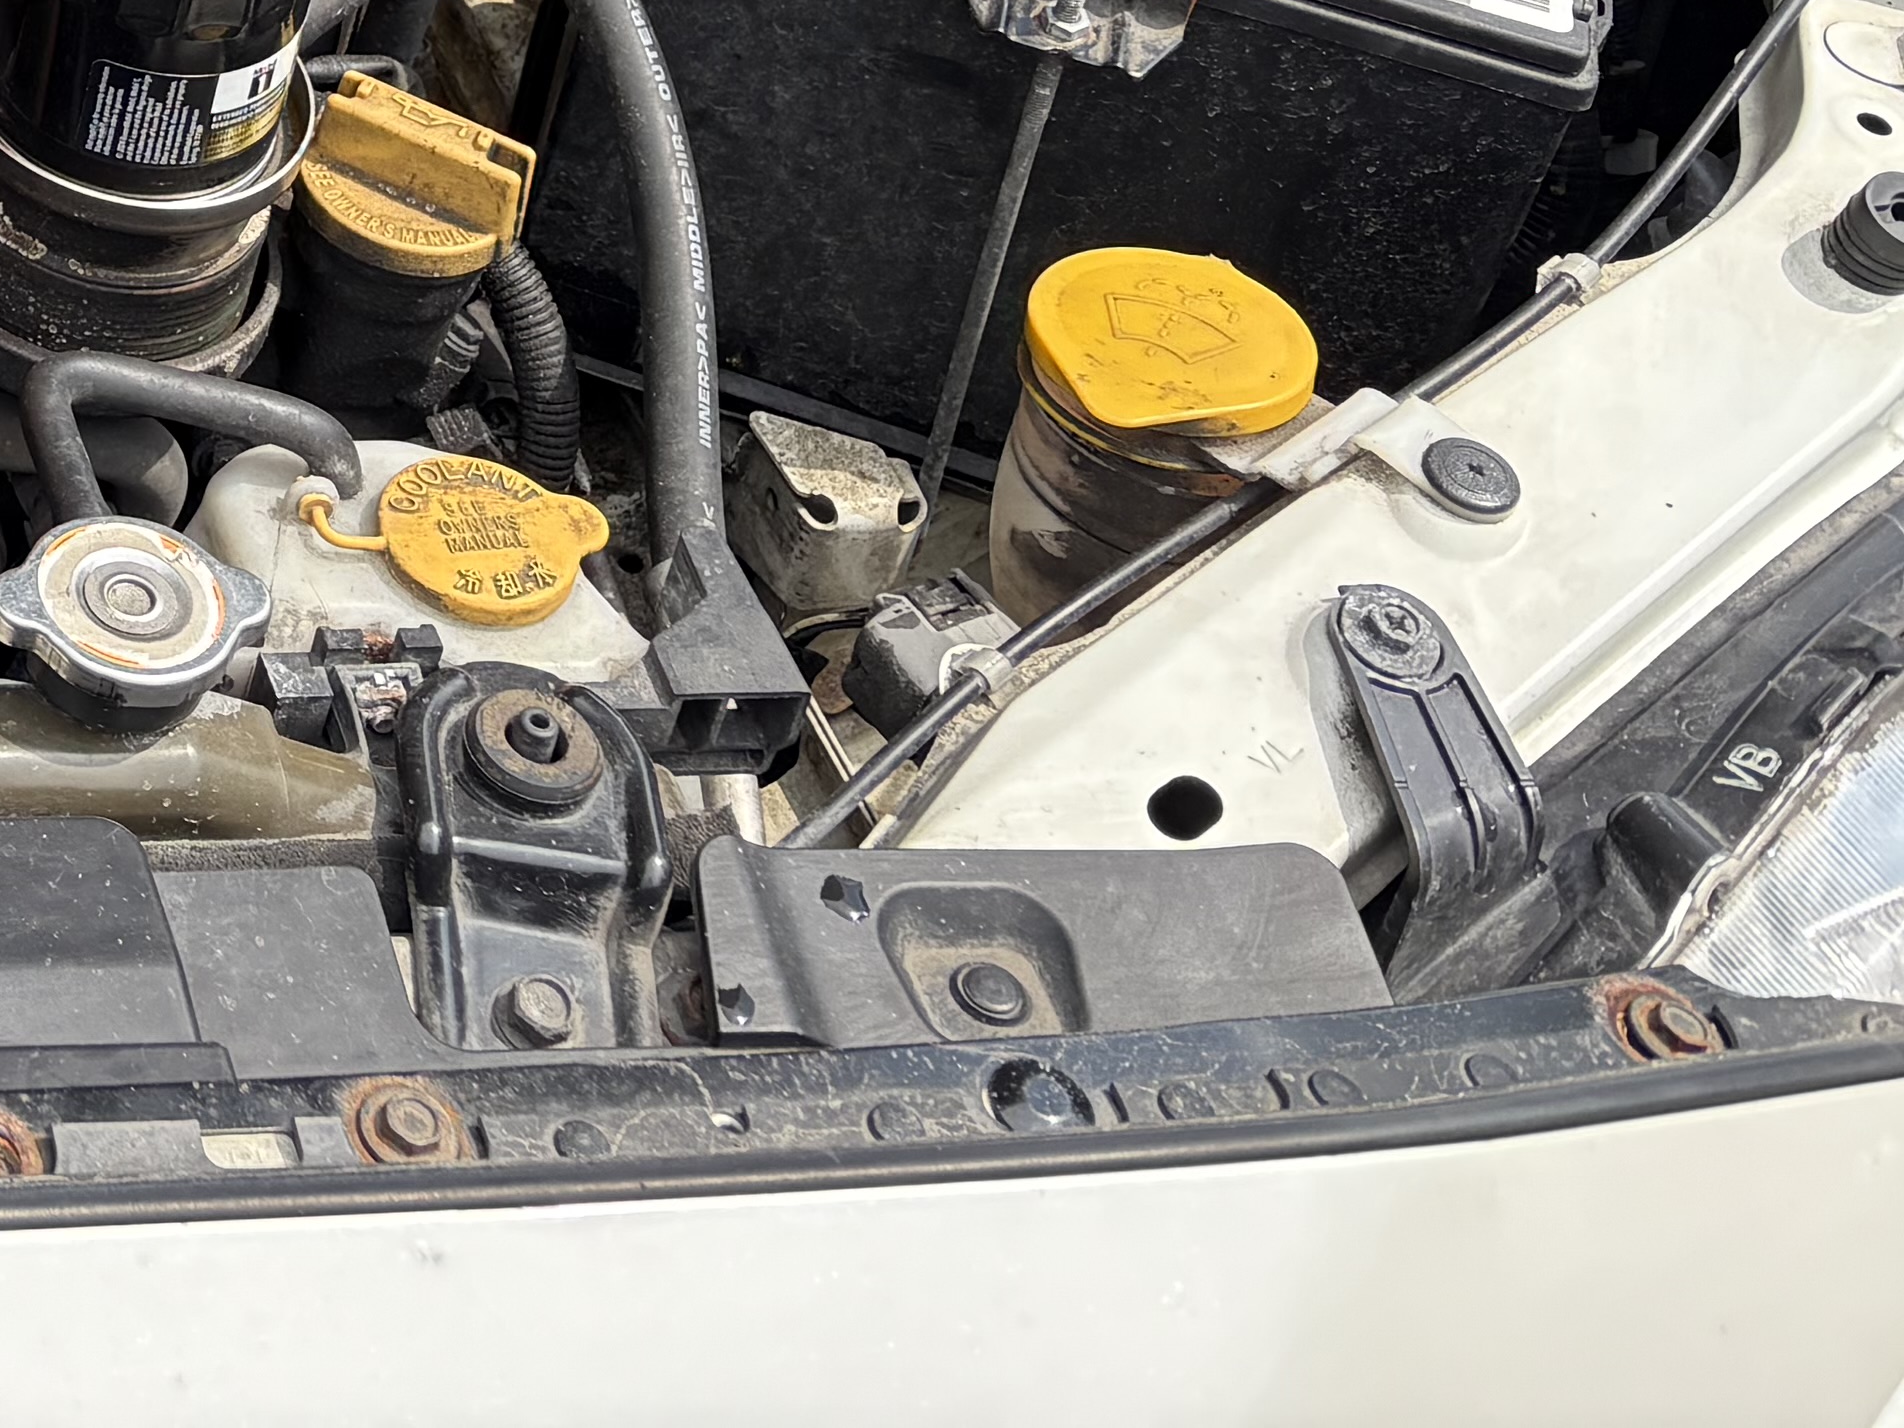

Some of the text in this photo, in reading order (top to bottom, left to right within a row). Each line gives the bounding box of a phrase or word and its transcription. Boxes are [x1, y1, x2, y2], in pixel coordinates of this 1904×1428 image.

[306, 161, 335, 189] SEE
[400, 227, 478, 246] MANUAL
[387, 458, 543, 513] COOLANT
[442, 500, 485, 517] SEE
[444, 531, 529, 554] MANUAL
[1712, 742, 1783, 792] VB
